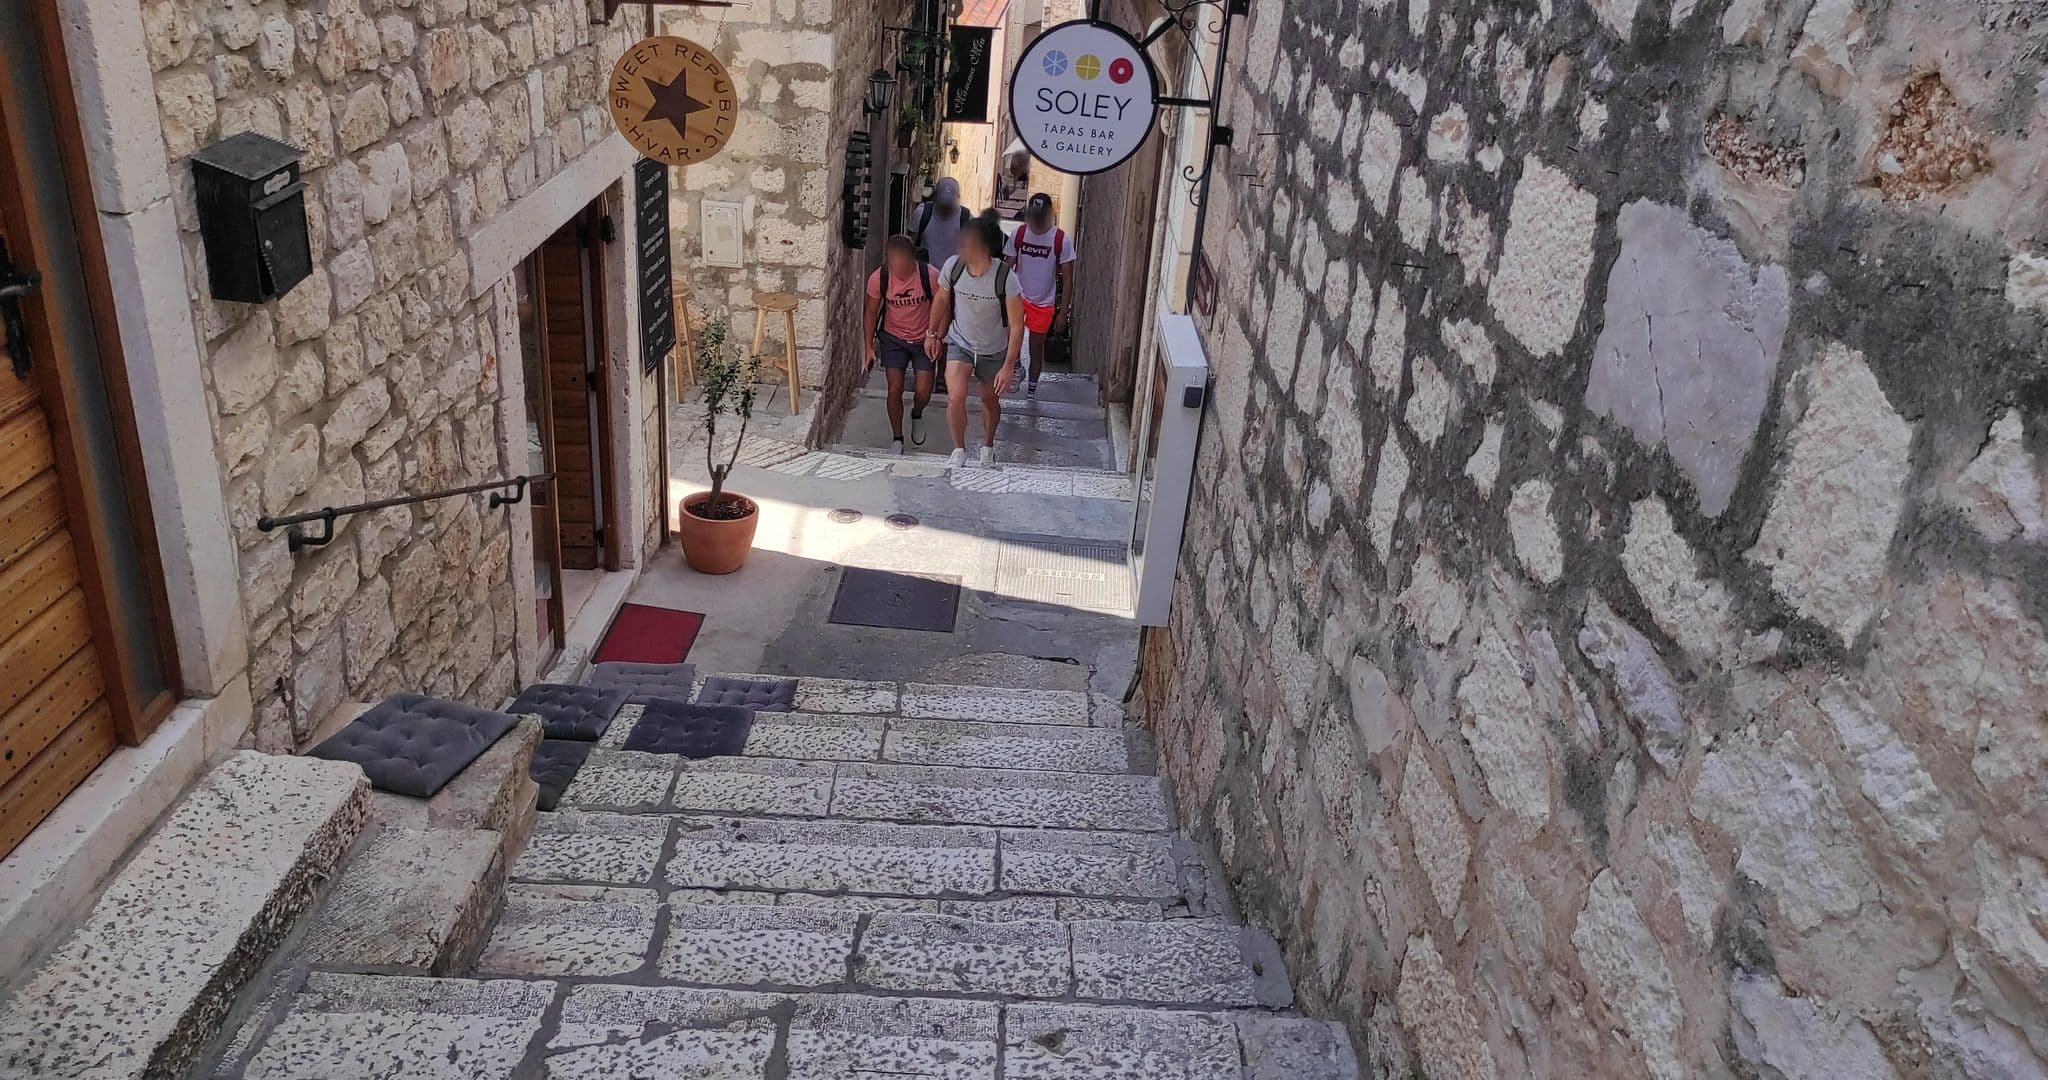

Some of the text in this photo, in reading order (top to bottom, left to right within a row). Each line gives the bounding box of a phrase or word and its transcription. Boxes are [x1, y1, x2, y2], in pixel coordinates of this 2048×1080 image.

[615, 44, 731, 149] SWEET REPUBLIC
[1035, 87, 1132, 121] SOLEY
[628, 125, 692, 160] HVAR
[1040, 139, 1113, 157] & GALLERY
[1044, 123, 1115, 141] TAPAS BAR
